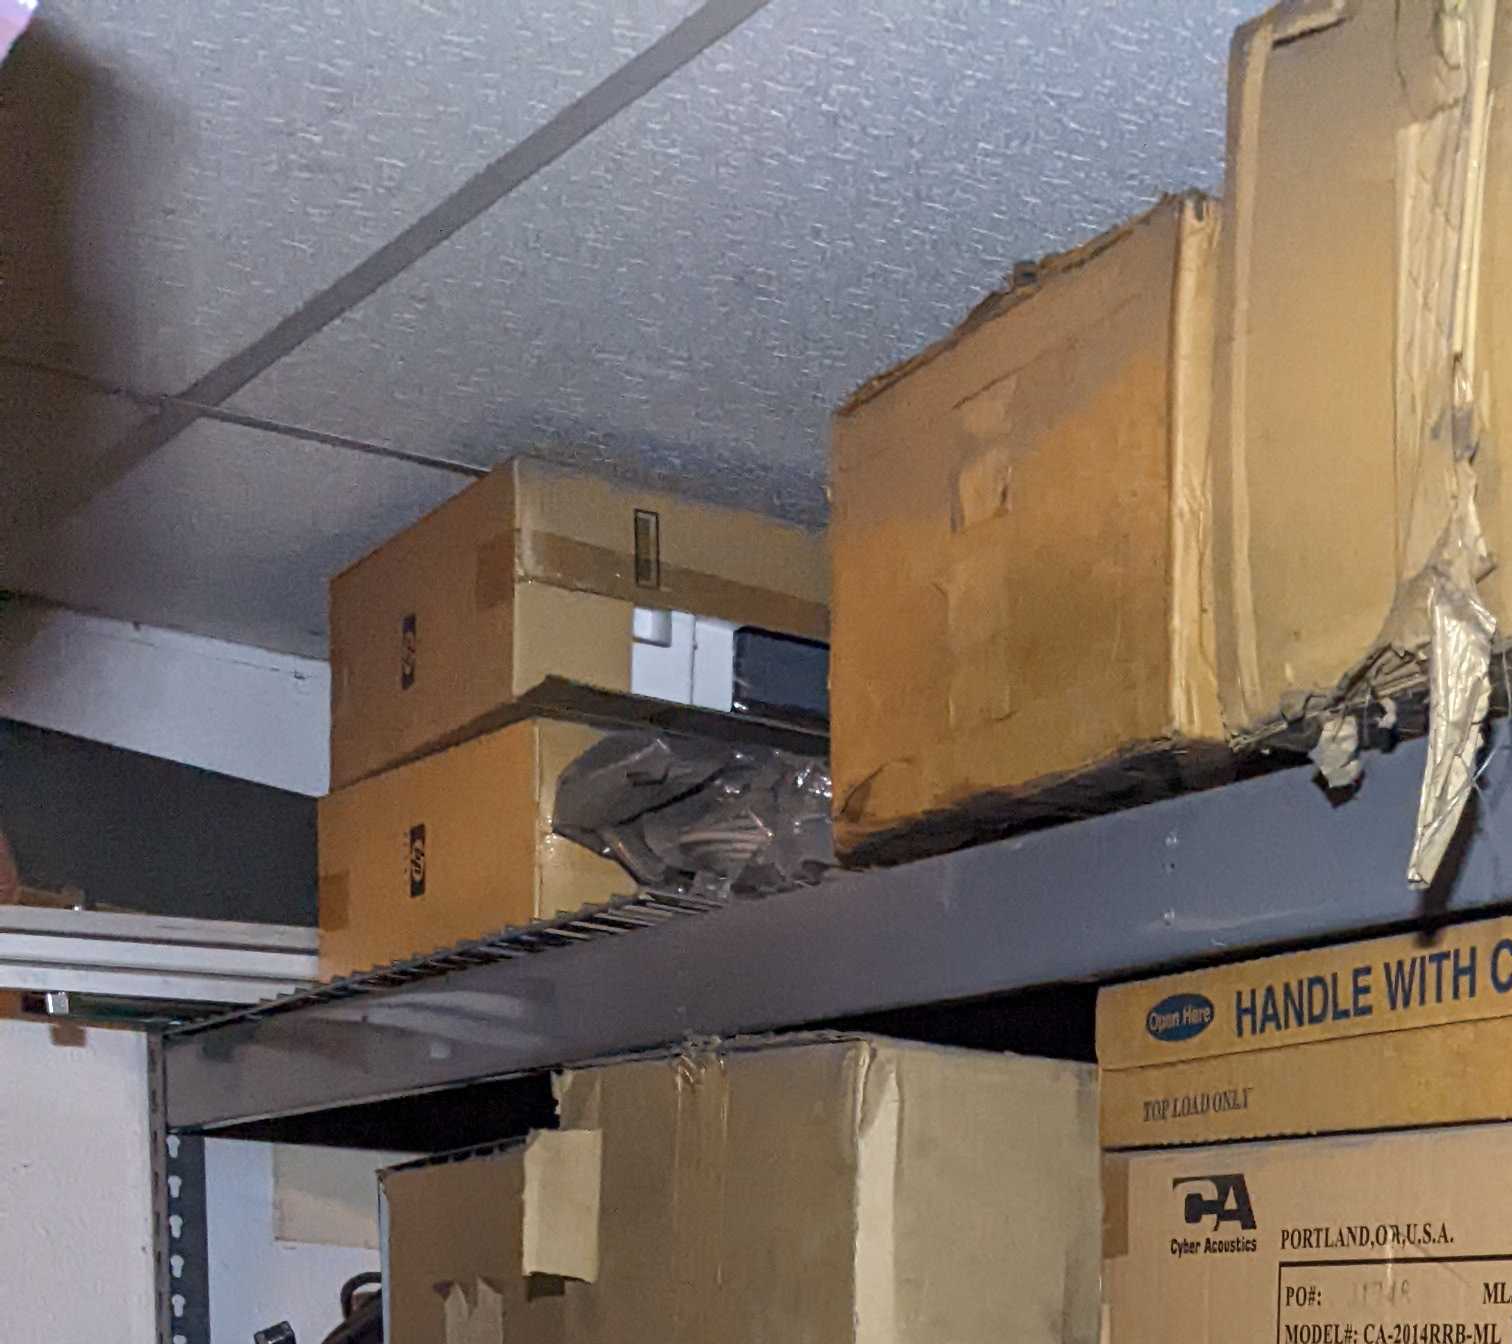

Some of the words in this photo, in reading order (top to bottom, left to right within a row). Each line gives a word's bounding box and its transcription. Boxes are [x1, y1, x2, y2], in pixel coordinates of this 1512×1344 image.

[1235, 965, 1374, 1038] HANDLE
[1384, 946, 1478, 1011] WITH
[1150, 1009, 1180, 1033] Open
[1182, 1005, 1212, 1026] Here
[1143, 1099, 1168, 1122] TOP
[1171, 1093, 1211, 1118] LOAD
[1213, 1087, 1254, 1113] ONLY
[1170, 1238, 1201, 1258] Cyber
[1203, 1236, 1257, 1254] Acoustics
[1285, 1285, 1322, 1307] PO#:
[1284, 1323, 1358, 1344] MODEL#:
